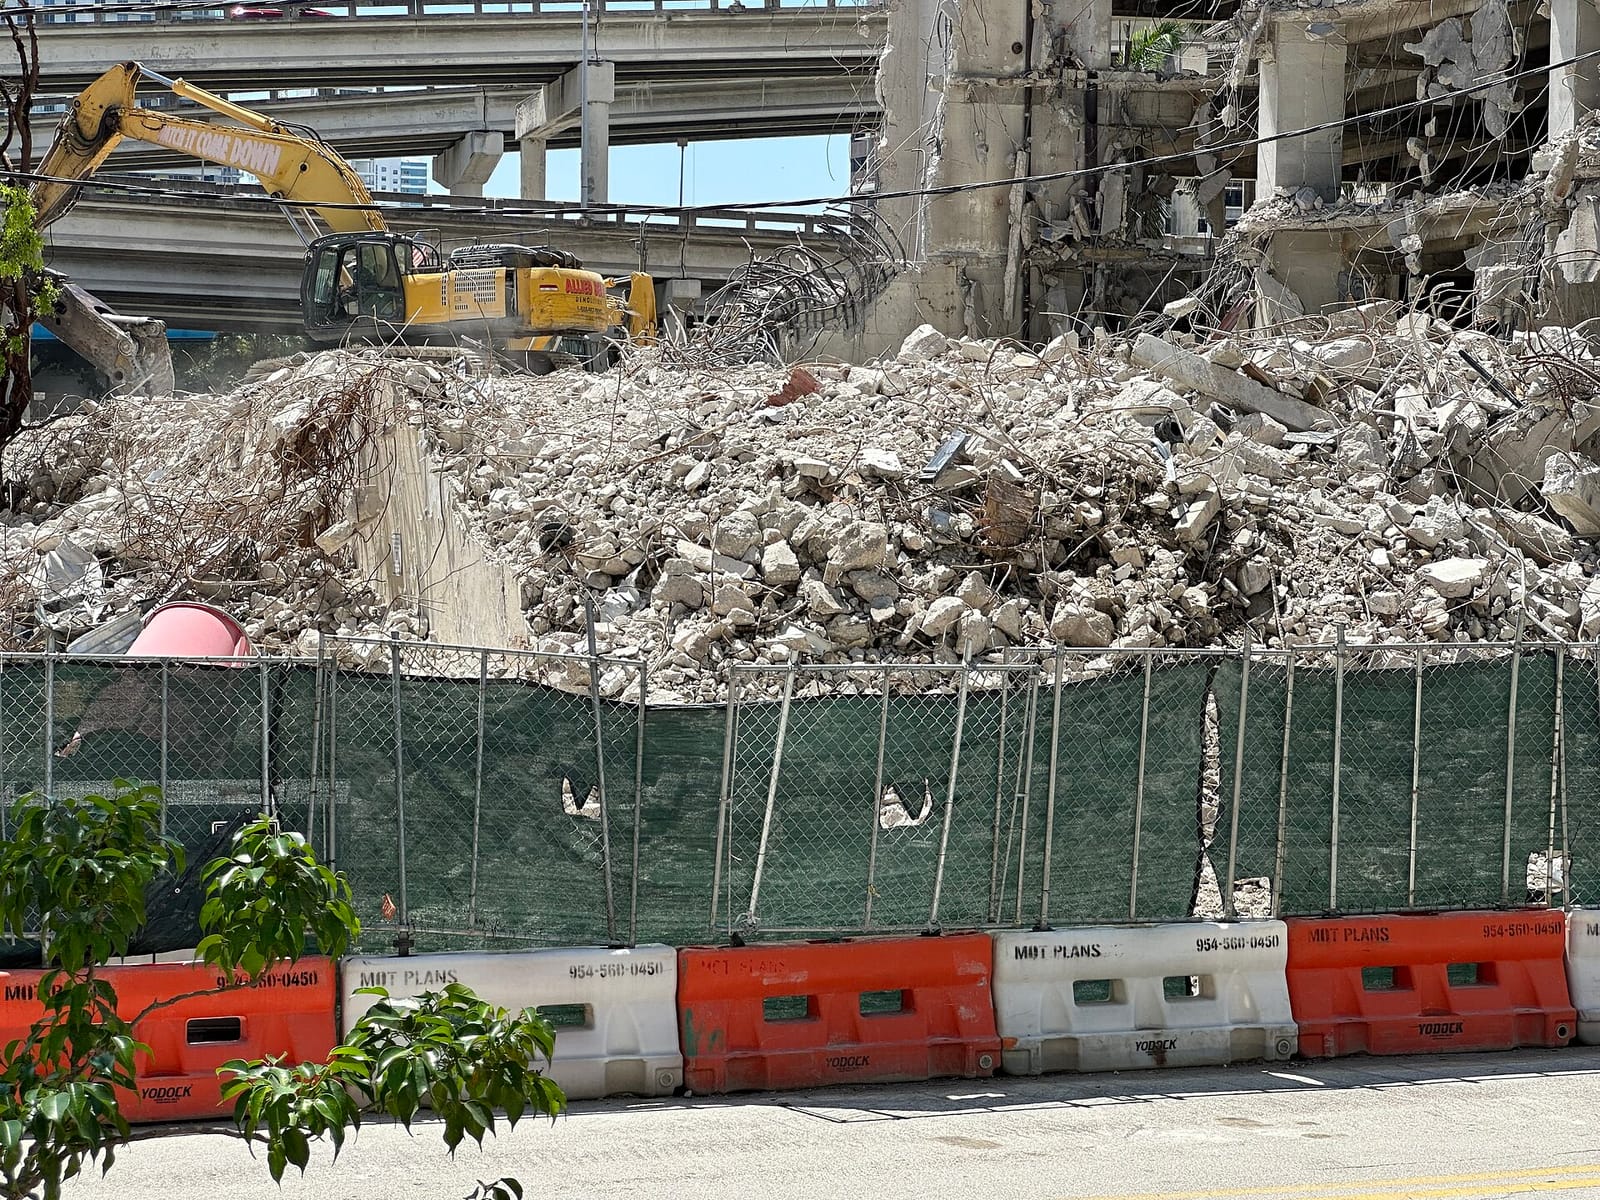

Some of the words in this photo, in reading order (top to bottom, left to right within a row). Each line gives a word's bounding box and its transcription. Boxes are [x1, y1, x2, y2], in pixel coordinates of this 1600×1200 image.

[197, 132, 231, 160] COME
[230, 137, 281, 176] DOWN
[1344, 927, 1390, 942] PLANS
[1483, 921, 1561, 938] 954-560-0450
[1014, 945, 1048, 960] MOT
[1053, 943, 1101, 959] PLANS
[1196, 934, 1279, 952] 954-560-0450
[360, 971, 397, 987] MOT
[404, 969, 458, 986] PLANS
[569, 961, 663, 979] 954-560-0450
[1418, 1022, 1464, 1035] YODOCK
[1135, 1038, 1177, 1051] YODOCK
[825, 1055, 870, 1067] YODOCK
[142, 1085, 193, 1099] YODOCK
